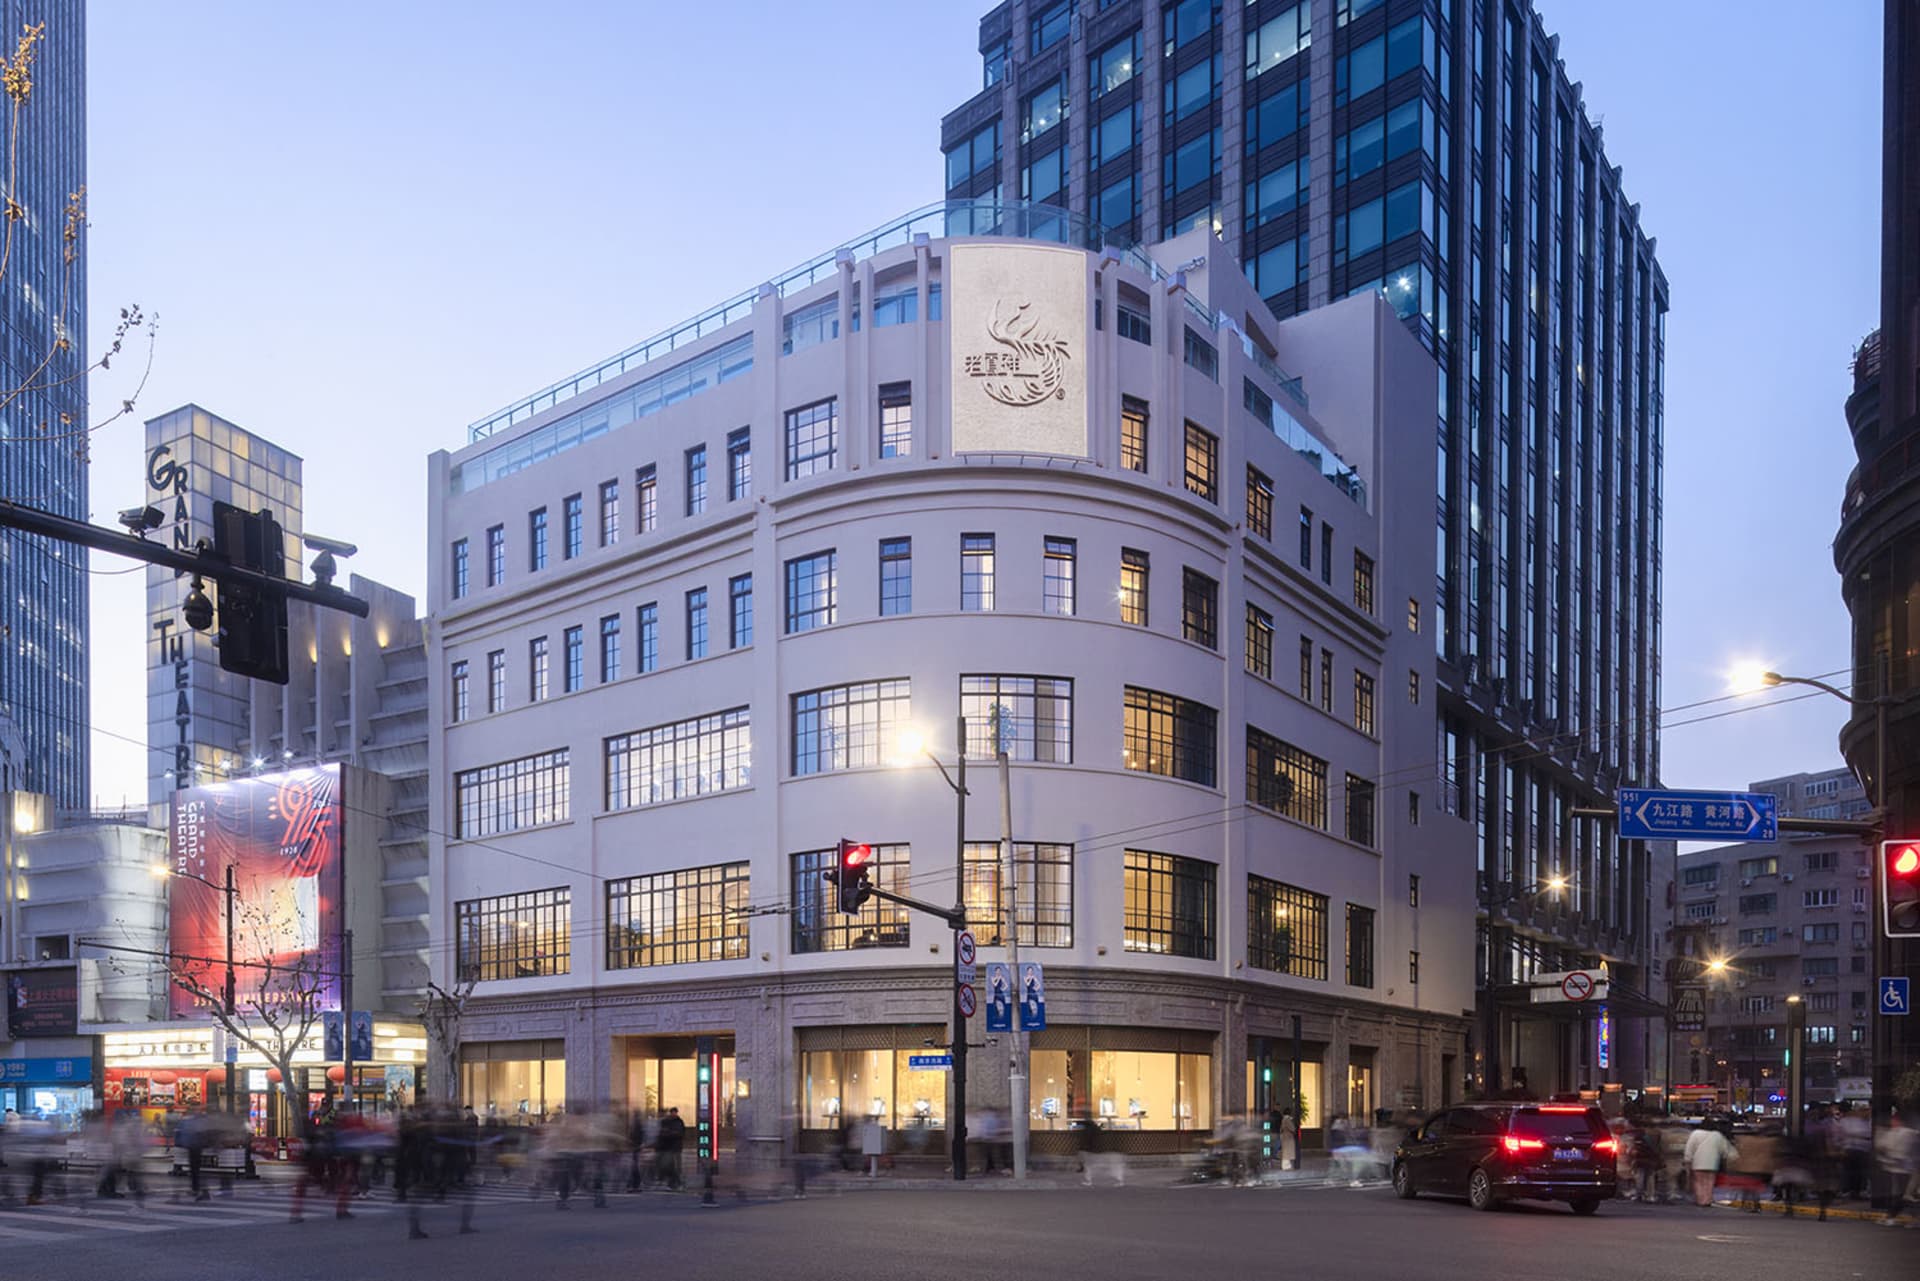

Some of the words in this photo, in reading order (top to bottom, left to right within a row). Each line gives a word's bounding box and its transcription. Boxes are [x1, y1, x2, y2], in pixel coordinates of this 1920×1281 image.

[153, 619, 190, 790] THEATRE
[1652, 803, 1693, 818] 九江路
[1704, 805, 1745, 820] 黄河路
[187, 801, 198, 859] GRAND
